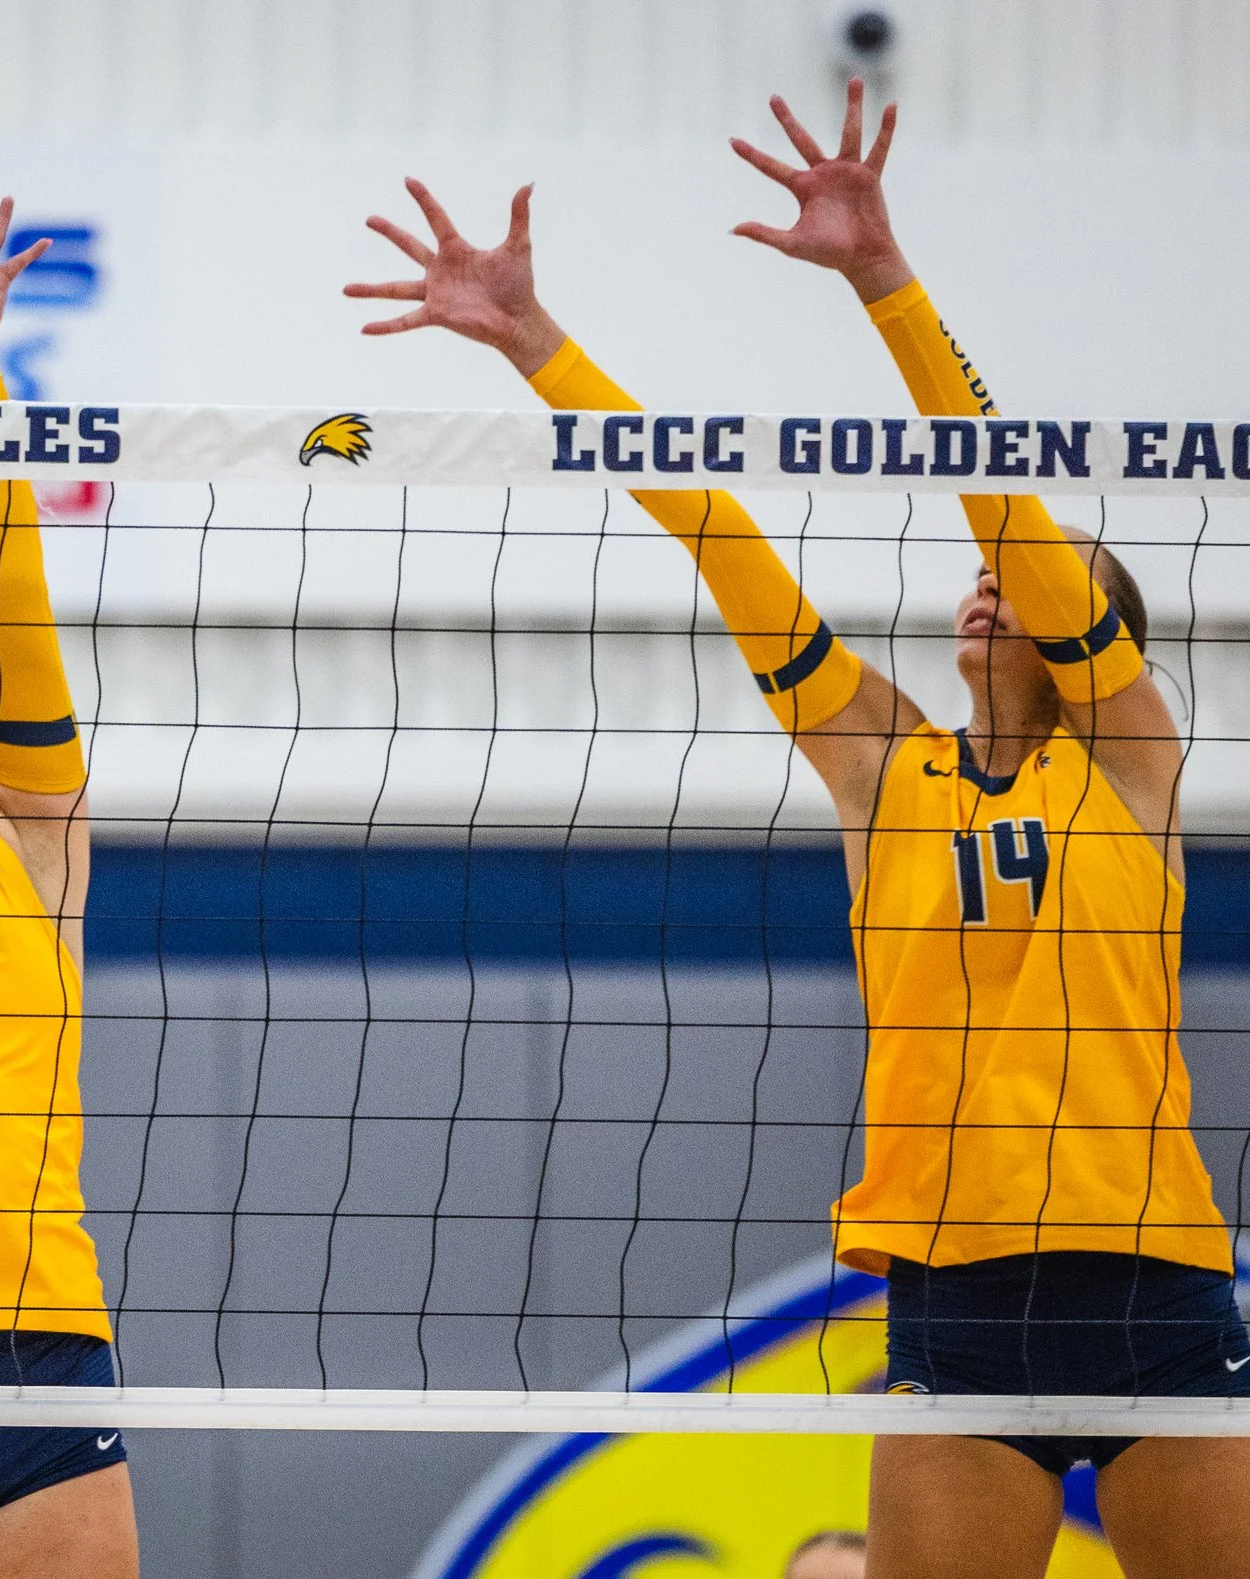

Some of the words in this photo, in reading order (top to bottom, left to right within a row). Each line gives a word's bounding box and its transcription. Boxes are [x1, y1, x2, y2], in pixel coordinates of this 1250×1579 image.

[552, 414, 744, 472] LCCC
[779, 418, 1091, 478] GOLDEN
[950, 817, 1049, 926] 14
